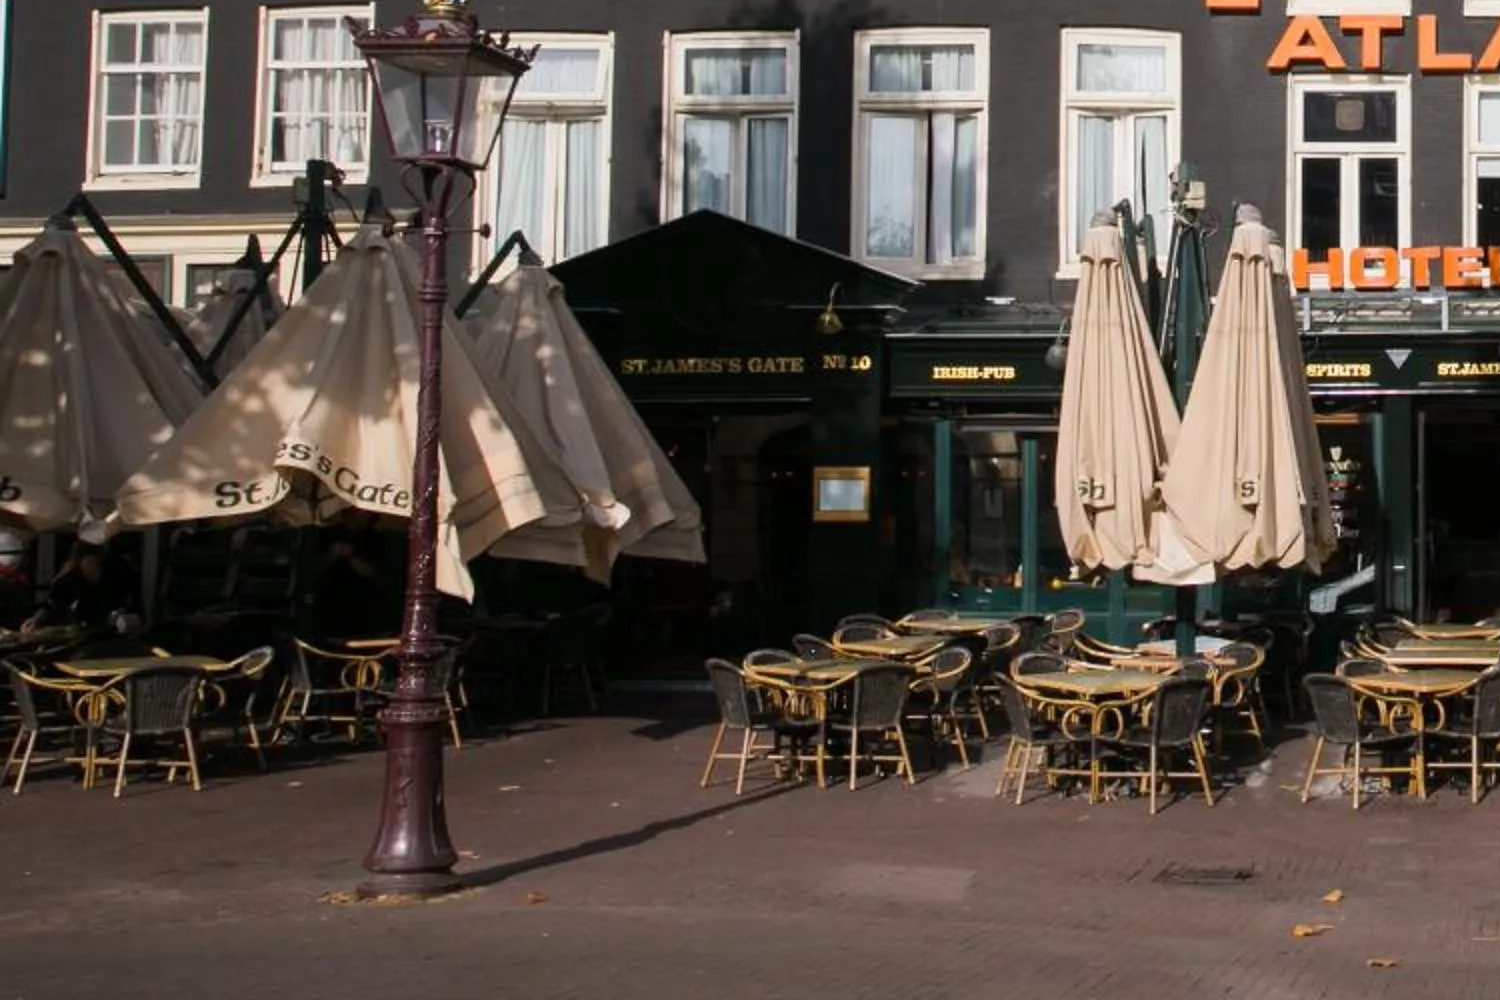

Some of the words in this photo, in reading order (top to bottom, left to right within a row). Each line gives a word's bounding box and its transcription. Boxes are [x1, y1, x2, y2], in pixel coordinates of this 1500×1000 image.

[747, 357, 803, 372] GATE
[850, 355, 872, 370] 10
[1306, 363, 1371, 377] SPIRITS
[334, 466, 410, 508] Gate
